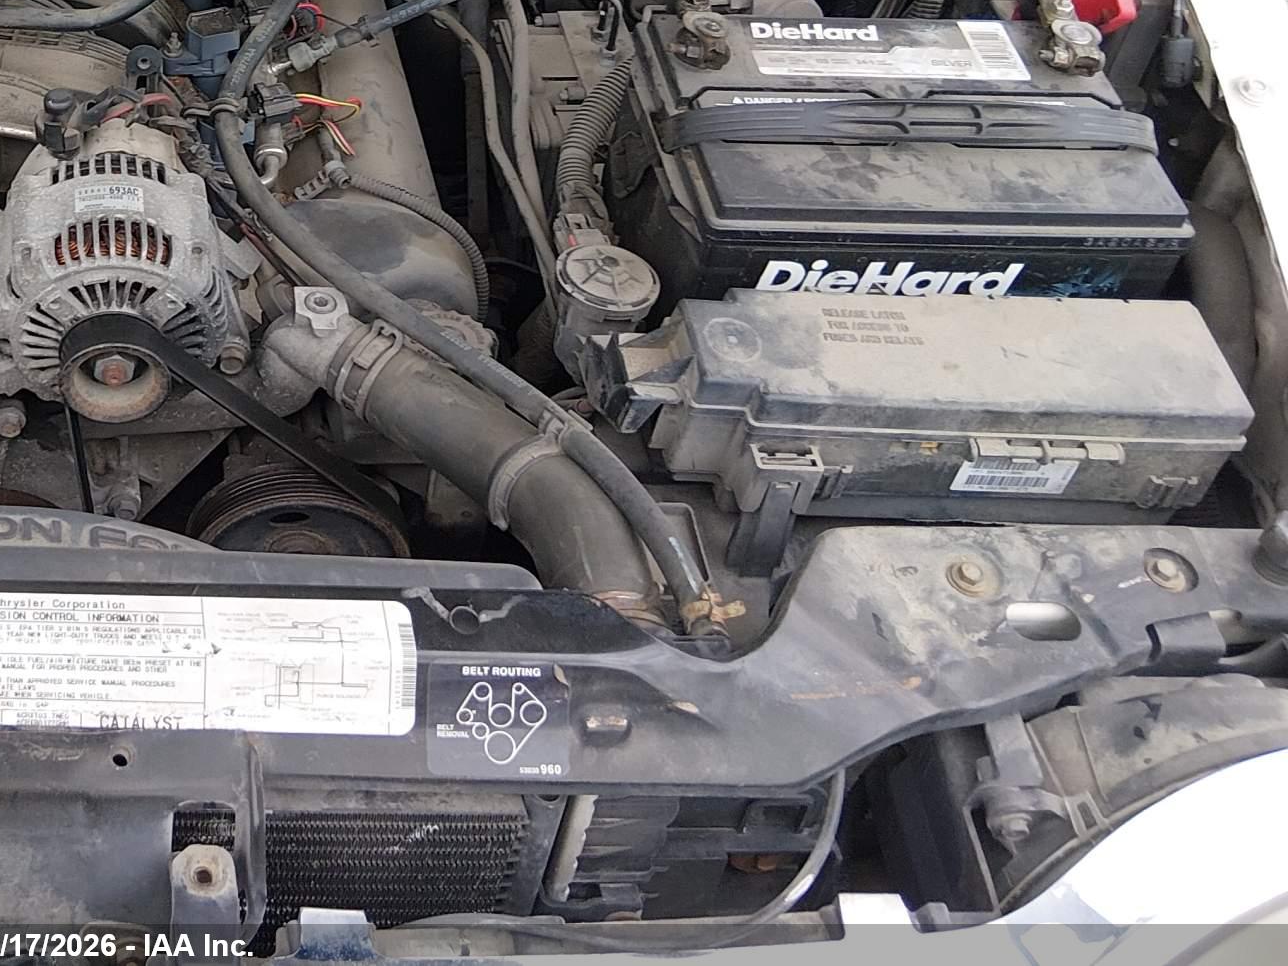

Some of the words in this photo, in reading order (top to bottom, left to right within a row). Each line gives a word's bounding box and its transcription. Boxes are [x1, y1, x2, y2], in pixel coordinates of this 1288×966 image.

[750, 22, 879, 42] DieHard
[931, 59, 972, 67] SILVER
[109, 186, 138, 195] 693AC
[755, 259, 1024, 297] DieHard
[53, 599, 125, 610] Corporation
[32, 611, 79, 621] CONTROL
[88, 612, 160, 622] INFORMATION
[462, 666, 490, 676] BELT
[492, 666, 541, 677] ROUTING
